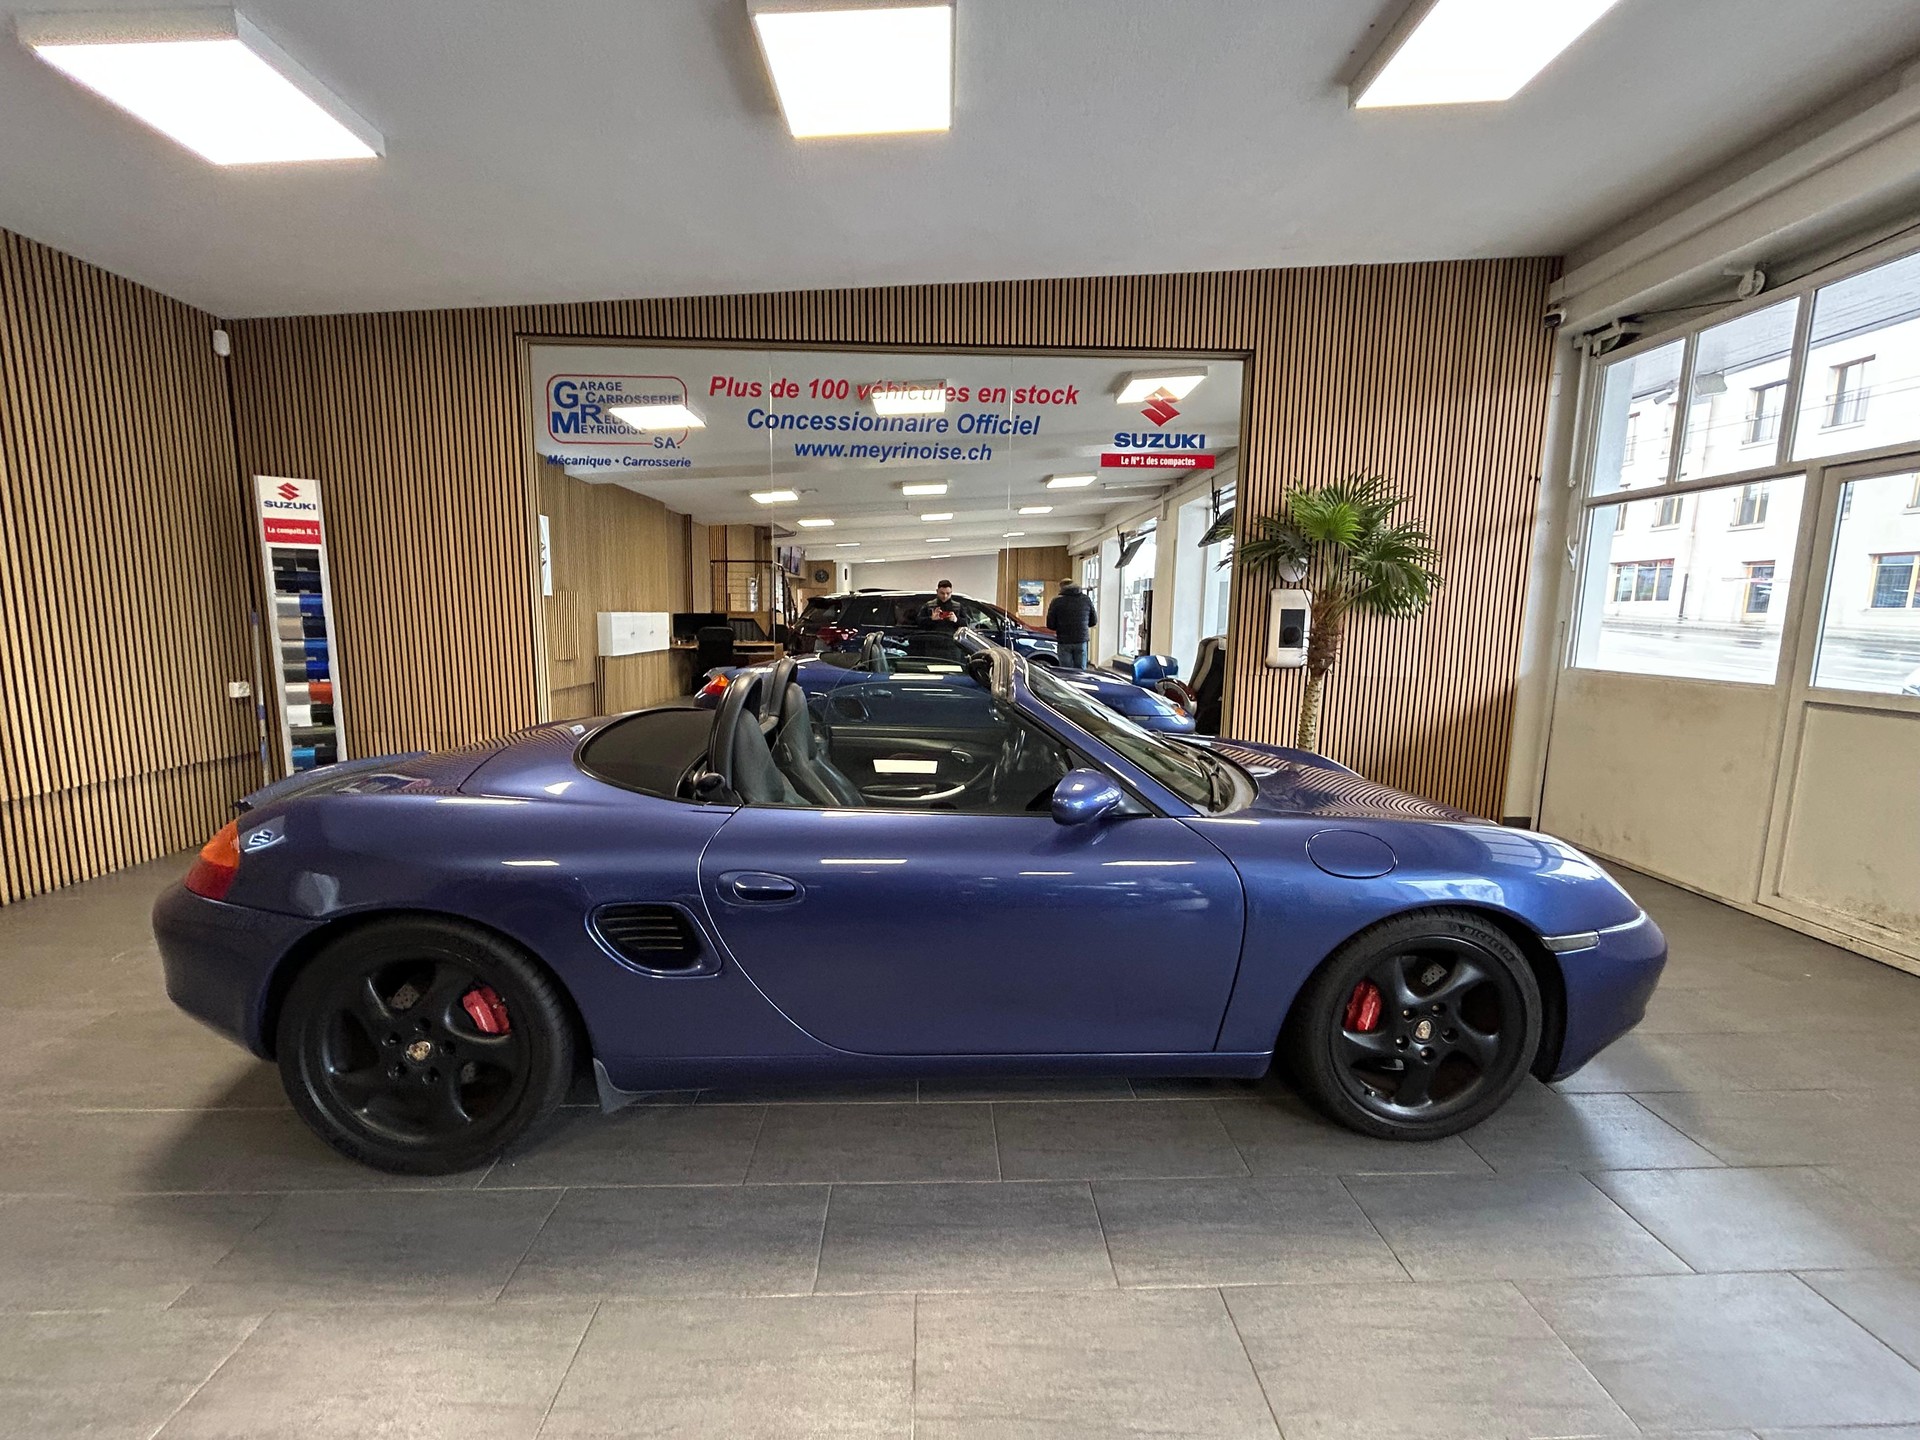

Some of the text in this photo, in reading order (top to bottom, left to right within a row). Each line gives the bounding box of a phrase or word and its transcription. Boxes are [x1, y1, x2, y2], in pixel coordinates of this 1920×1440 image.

[553, 380, 622, 409] GARAGE
[585, 391, 680, 405] CARROSSERIE
[709, 376, 1080, 405] Plus de 100 véhicules en stock
[747, 408, 1041, 436] Concessionnaire Officiel
[653, 436, 681, 449] SA.
[1113, 432, 1206, 449] SUZUKI
[795, 442, 992, 463] www.meyrinoise.ch
[547, 455, 692, 468] Mécanique Carrosserie
[1120, 456, 1129, 465] Le
[1146, 457, 1158, 466] des
[1159, 457, 1196, 467] compactes
[264, 501, 316, 510] SUZUKI
